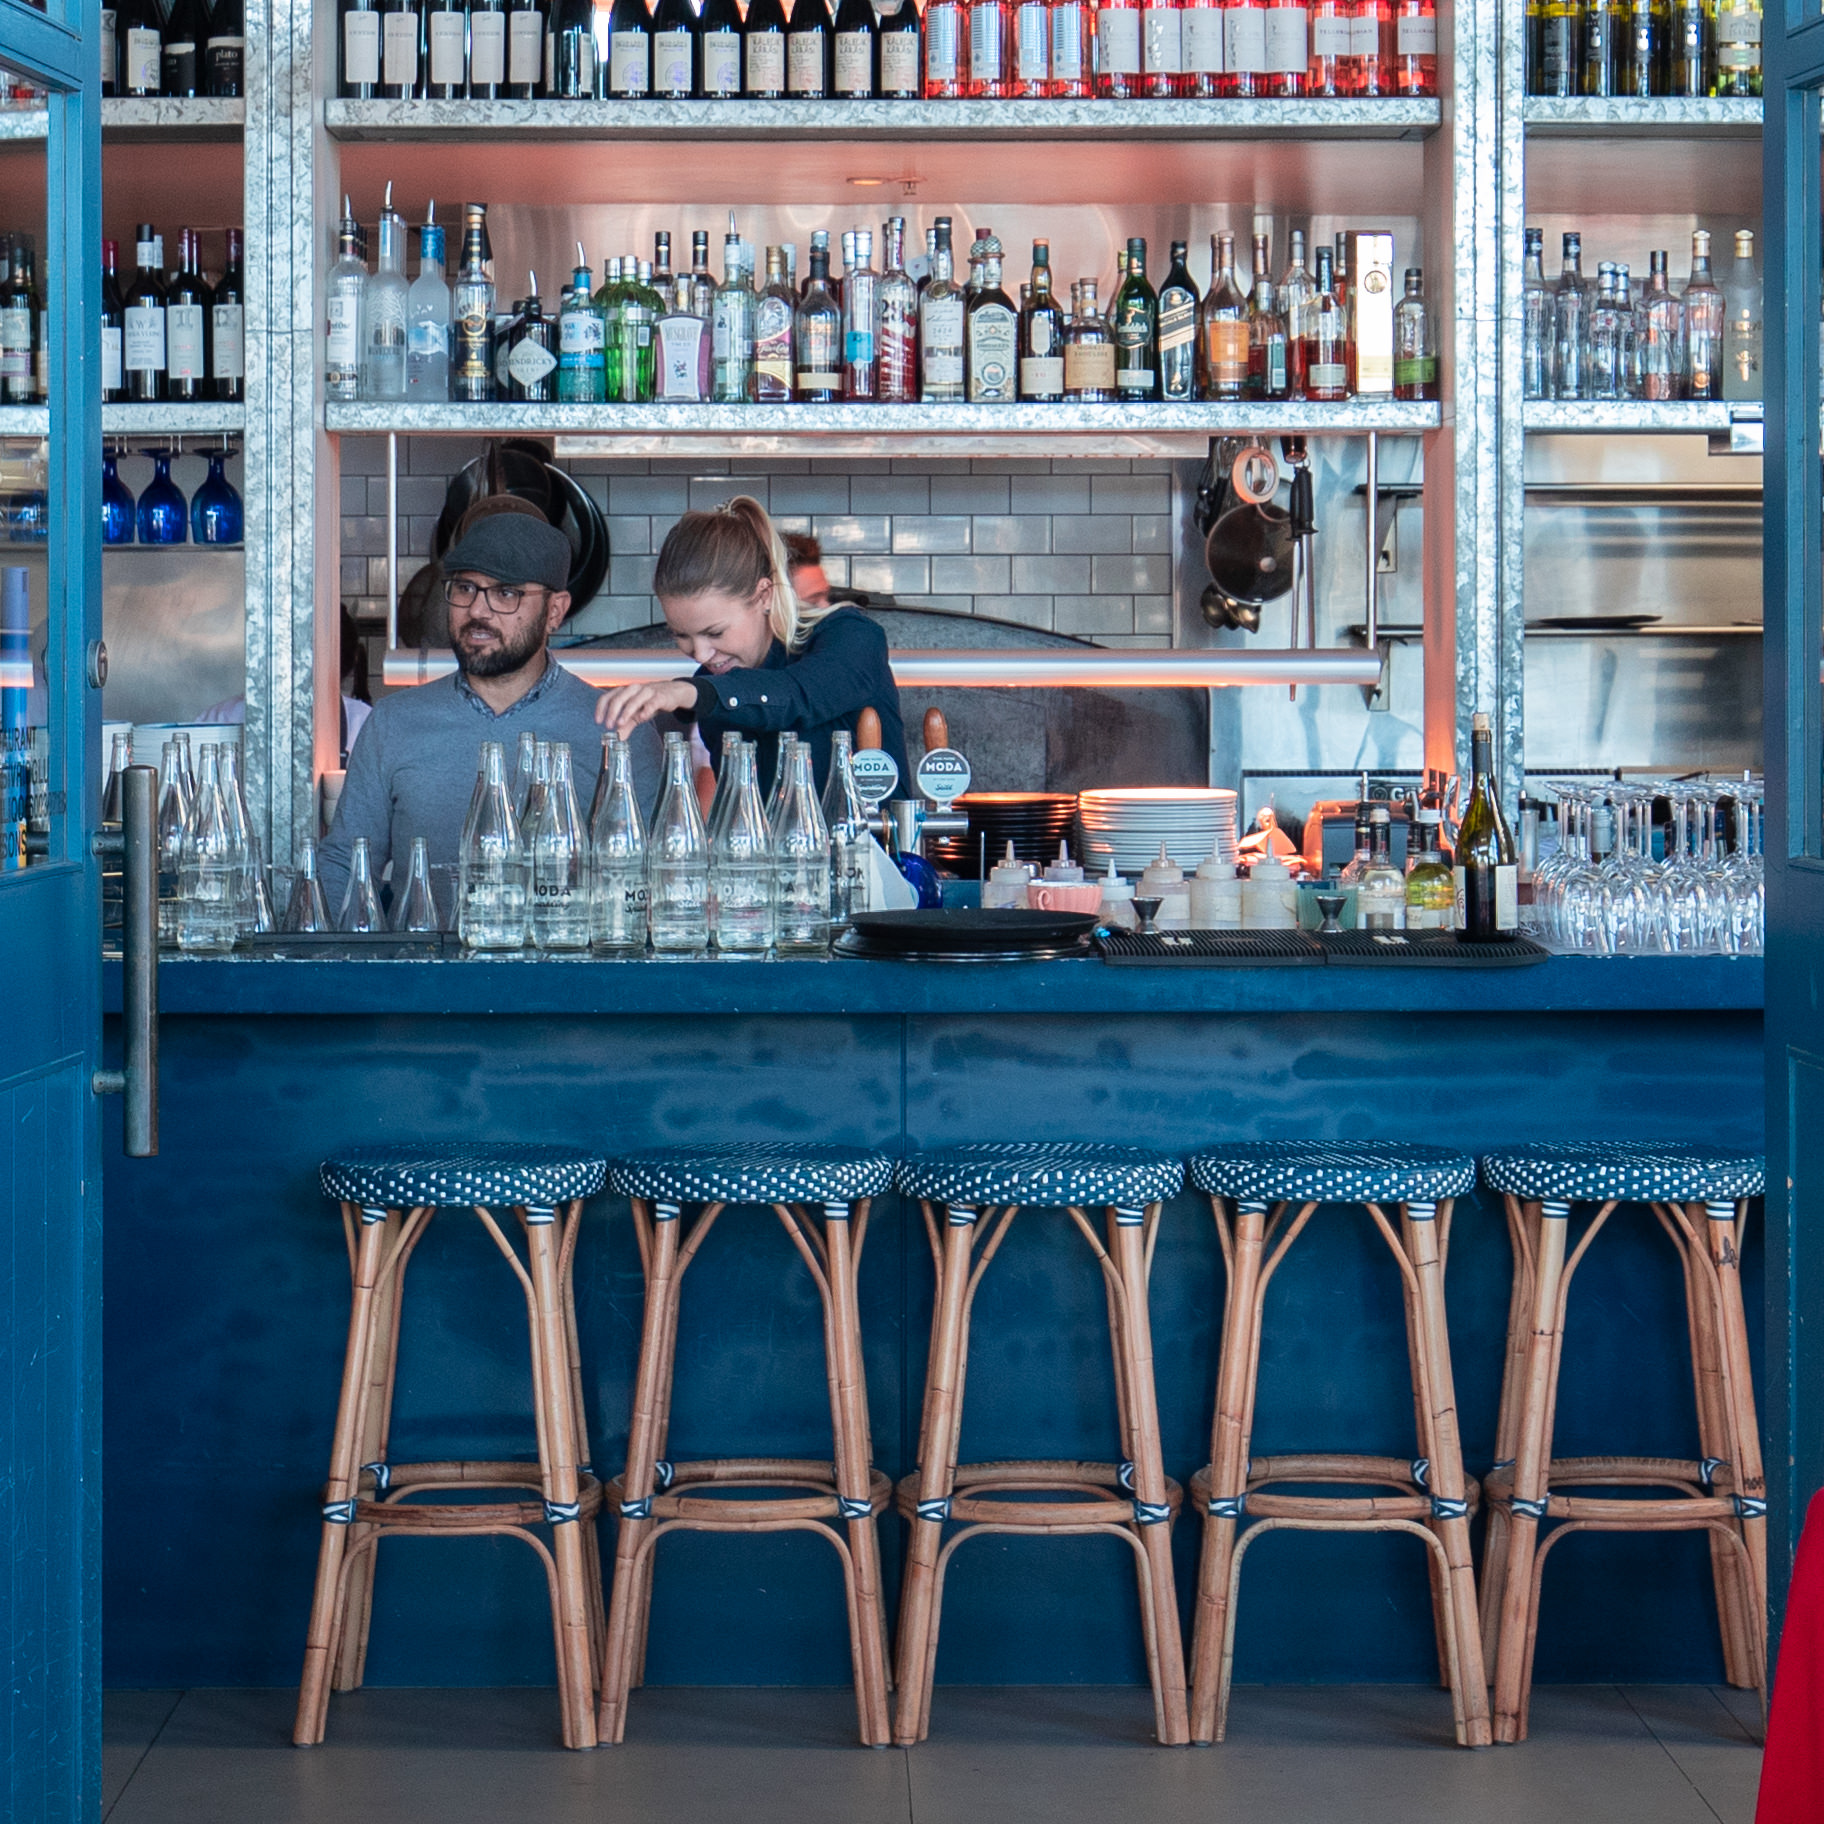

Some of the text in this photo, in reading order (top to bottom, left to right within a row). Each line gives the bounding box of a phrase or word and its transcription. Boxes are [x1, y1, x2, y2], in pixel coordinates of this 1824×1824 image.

[215, 49, 239, 62] plato
[854, 762, 890, 772] MODA
[925, 762, 962, 772] MODA
